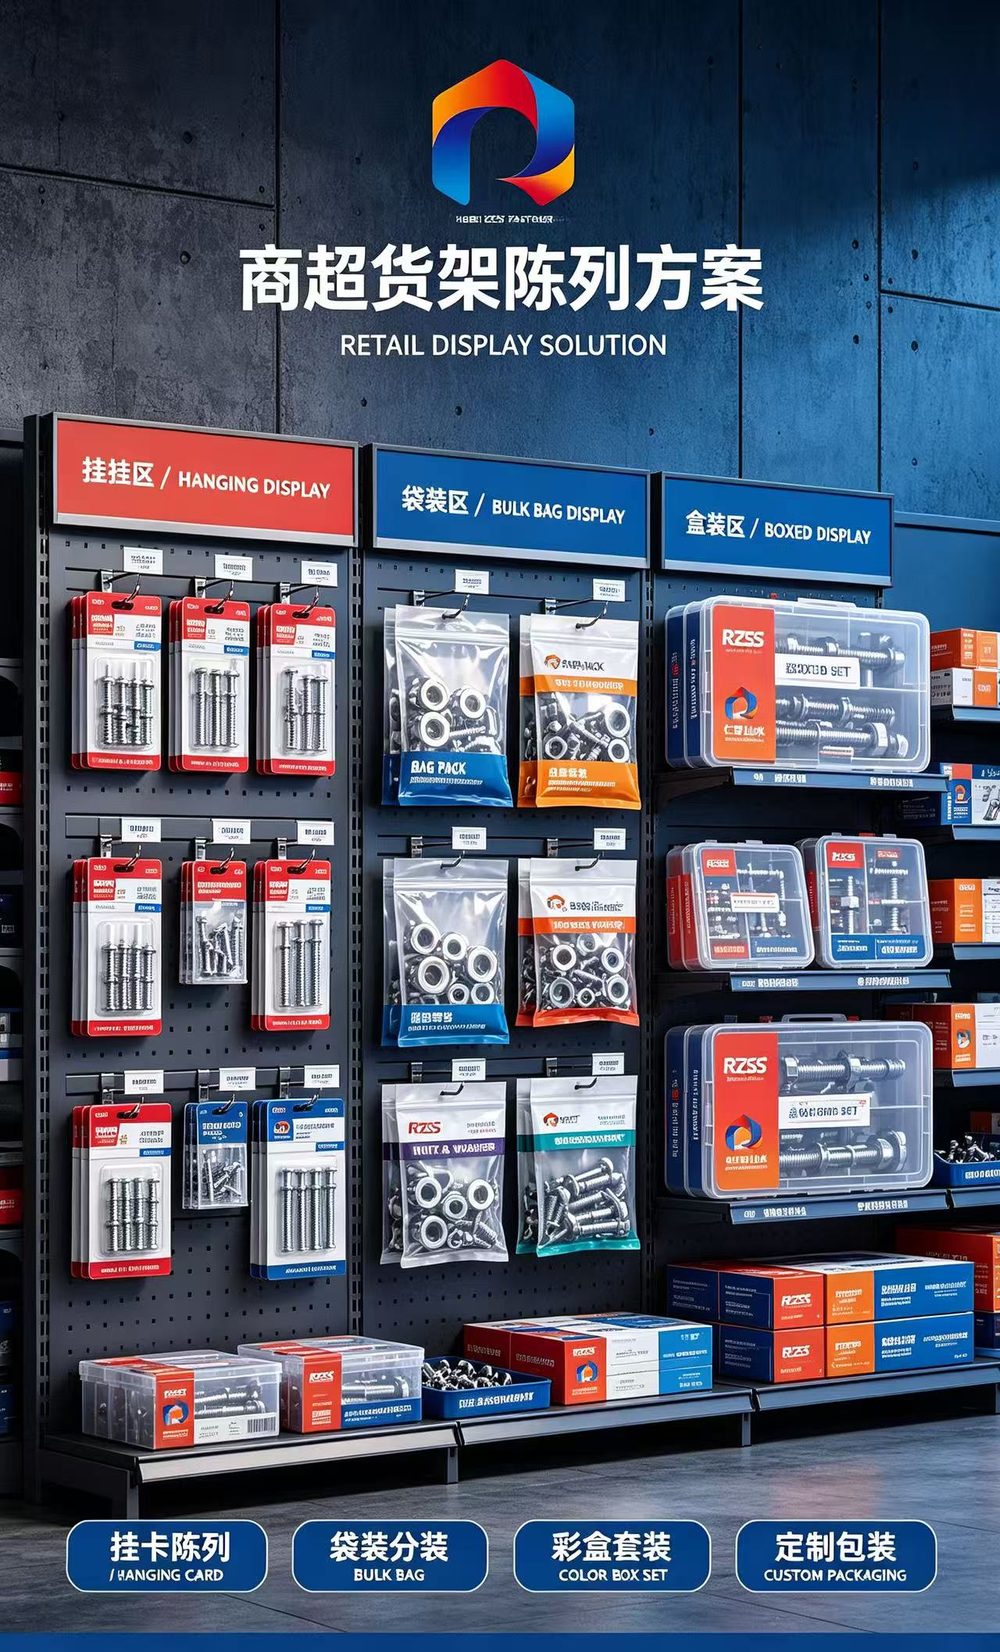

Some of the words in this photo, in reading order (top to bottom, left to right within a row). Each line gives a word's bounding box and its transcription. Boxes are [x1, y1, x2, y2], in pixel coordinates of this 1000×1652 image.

[81, 456, 155, 488] 挂挂区
[178, 470, 259, 494] HANGING
[263, 478, 331, 499] DISPLAY
[401, 484, 469, 515] 袋装区
[492, 499, 531, 518] BULK
[533, 502, 563, 520] BAG
[566, 505, 626, 525] DISPLAY
[685, 509, 746, 538] 盒装区
[764, 521, 813, 541] BOXED
[816, 526, 872, 545] DISPLAY
[722, 628, 765, 648] RZSS
[830, 665, 851, 677] SET
[410, 760, 435, 774] BAG
[437, 760, 467, 775] PACK
[723, 1056, 768, 1075] RZSS
